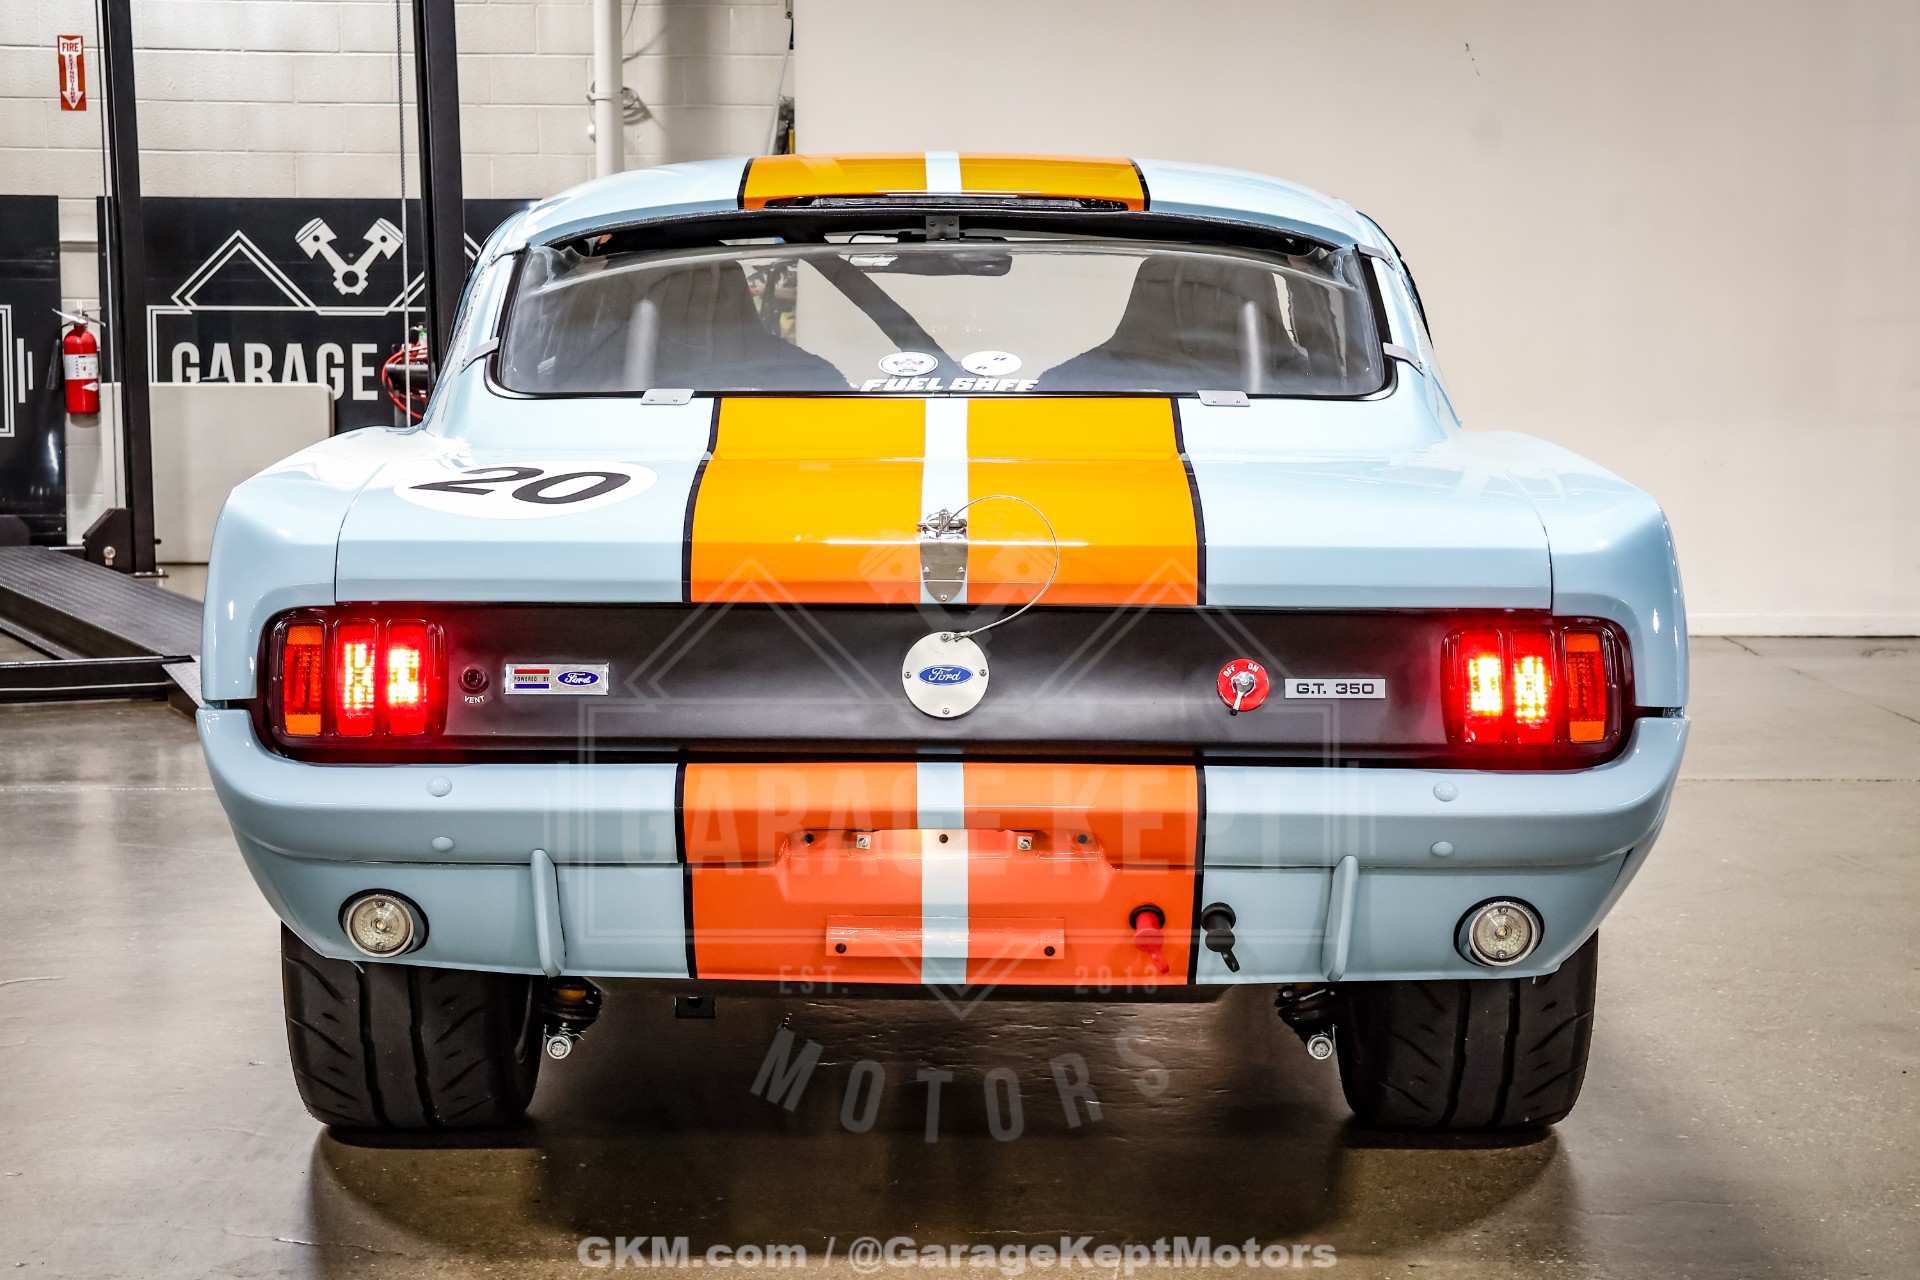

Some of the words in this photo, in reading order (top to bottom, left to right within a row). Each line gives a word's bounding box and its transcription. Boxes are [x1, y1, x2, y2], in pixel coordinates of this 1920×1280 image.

[61, 42, 80, 53] FIRE
[171, 342, 379, 401] GARAGE
[859, 377, 945, 392] FUEL
[949, 377, 1040, 392] SAFE
[408, 466, 632, 505] 20
[928, 667, 962, 681] Ford
[1223, 664, 1236, 678] OFF
[1247, 662, 1260, 673] ON
[564, 672, 592, 684] Ford
[1296, 683, 1327, 695] G.T.
[1335, 683, 1375, 695] 350
[464, 695, 485, 704] VENT
